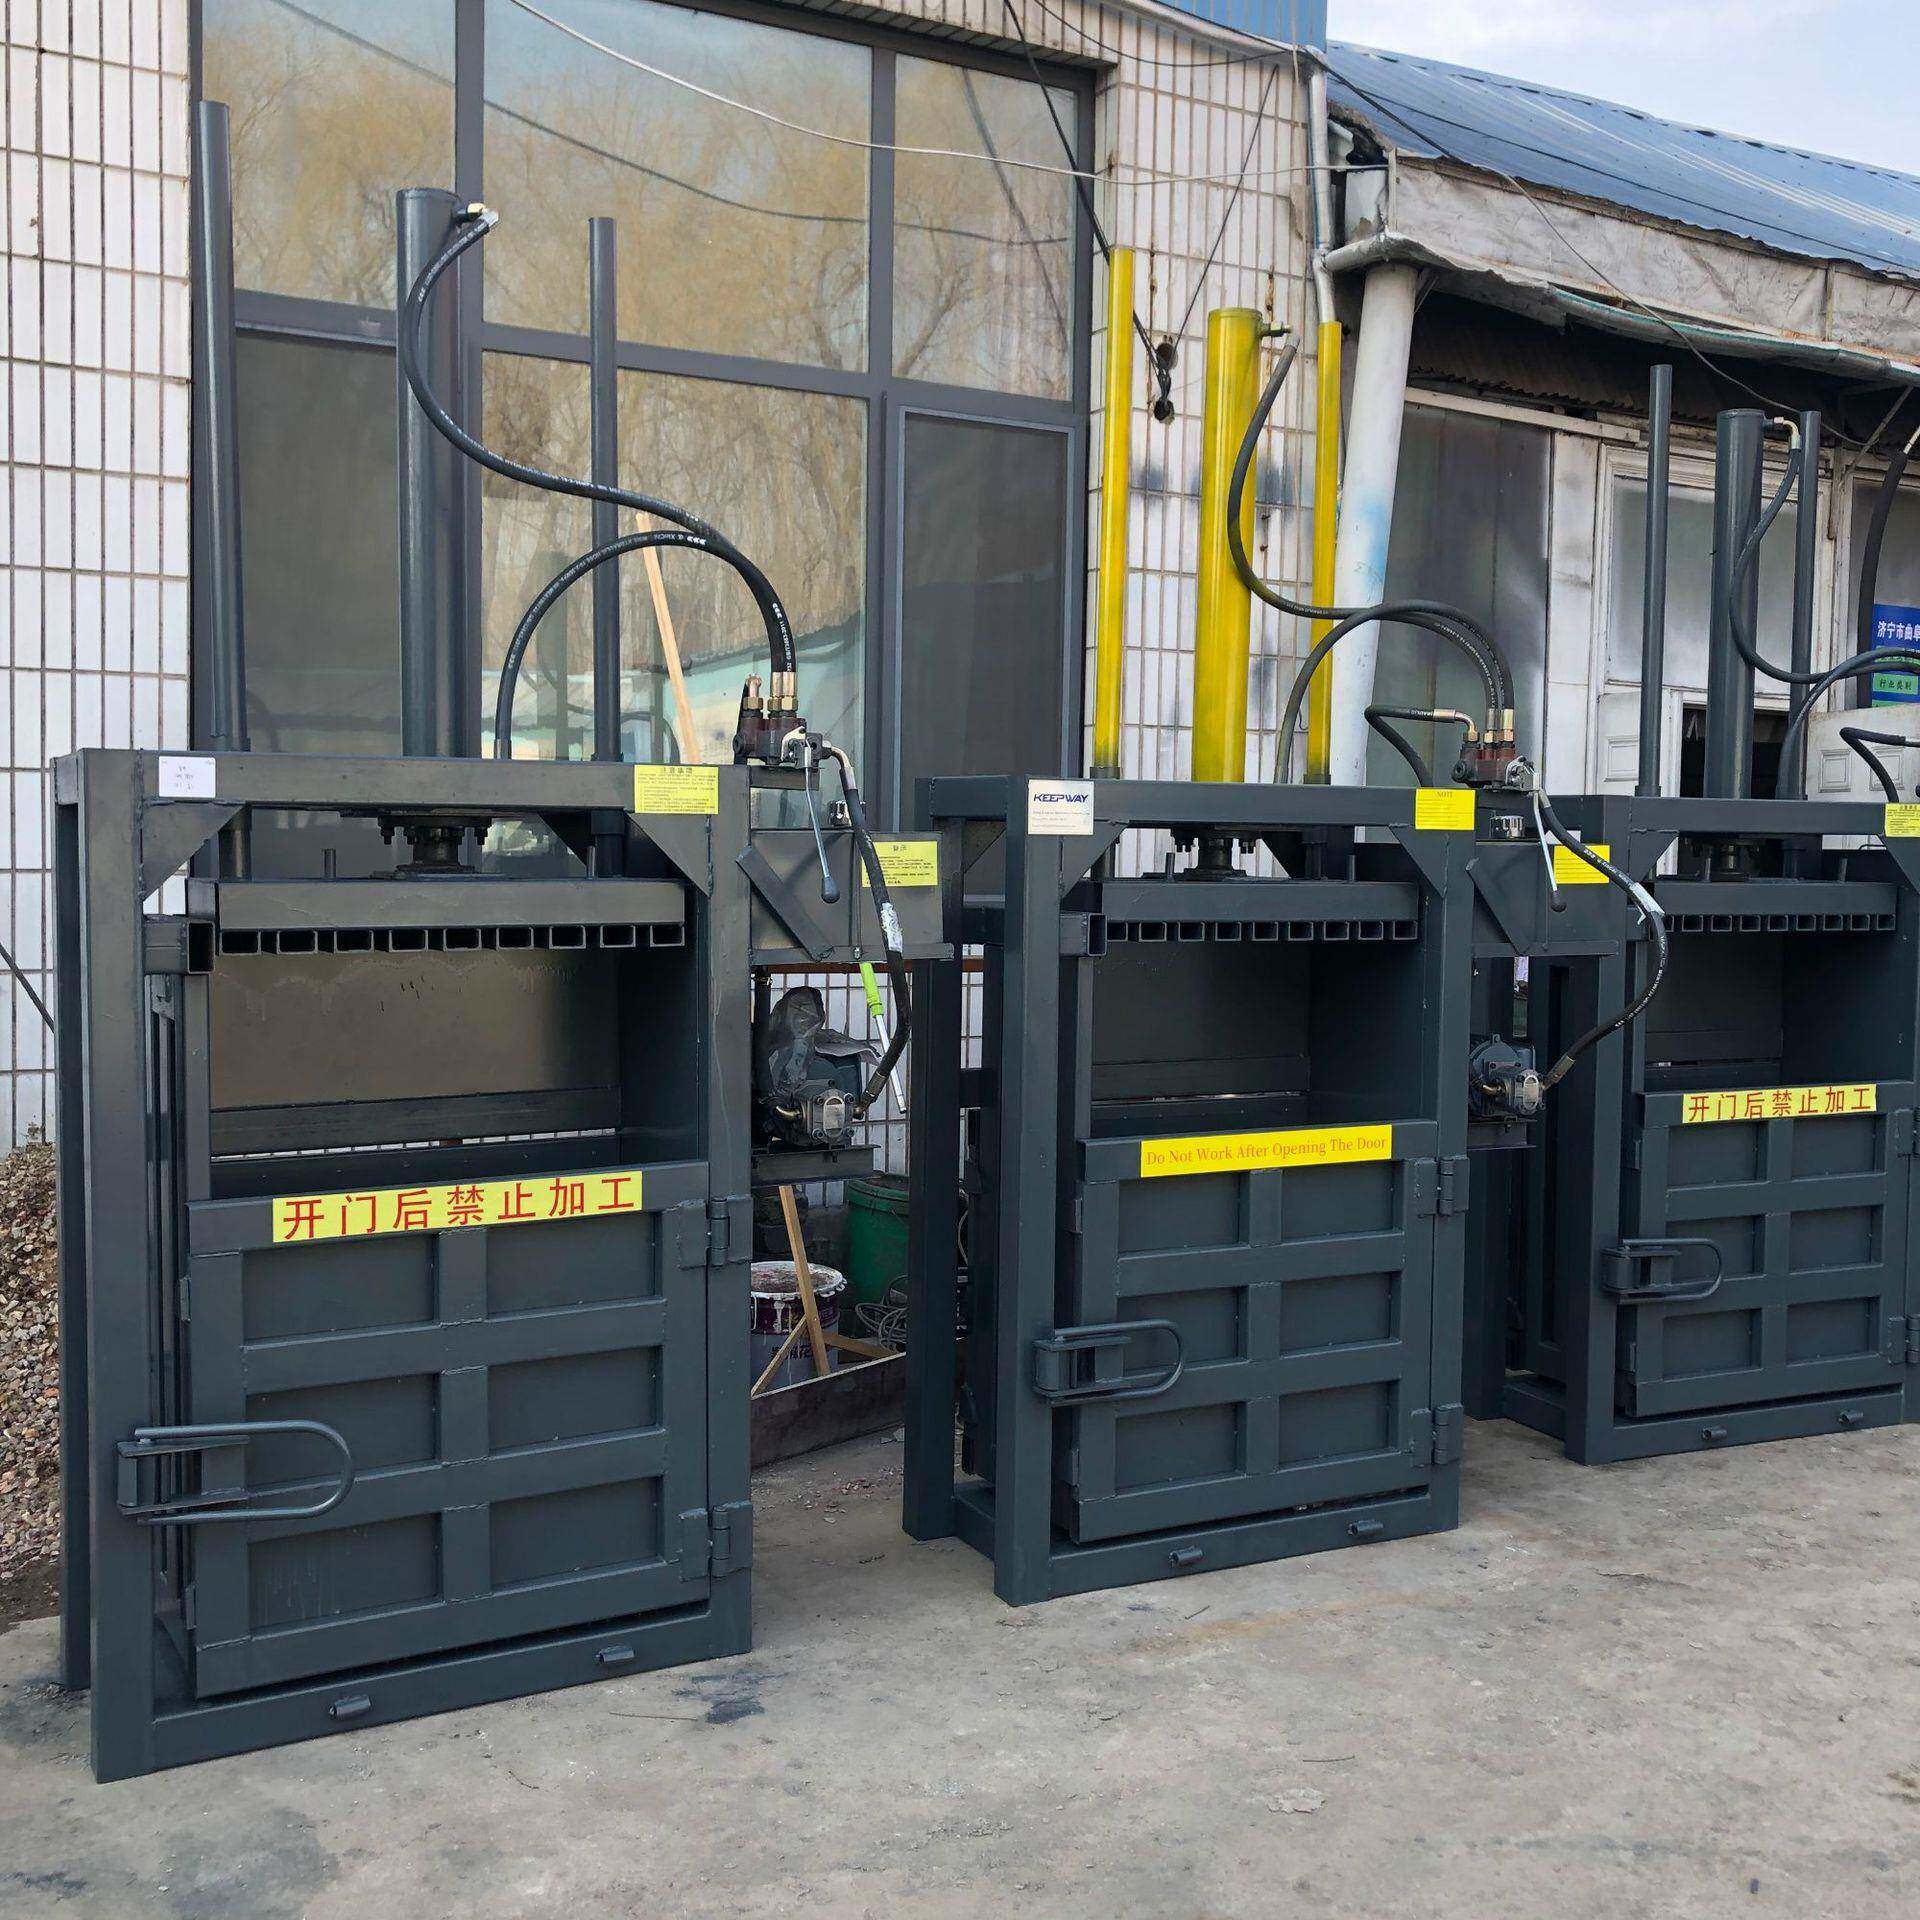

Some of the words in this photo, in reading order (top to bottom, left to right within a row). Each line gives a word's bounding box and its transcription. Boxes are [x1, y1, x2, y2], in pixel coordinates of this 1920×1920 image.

[1033, 793, 1089, 803] KEEPWAY
[1688, 1085, 1871, 1122] 开门后禁止加工
[1146, 1151, 1166, 1165] Do
[1169, 1149, 1193, 1164] Not
[1196, 1145, 1233, 1161] Work
[1236, 1143, 1269, 1159] After
[1272, 1139, 1327, 1159] Opening
[1330, 1137, 1354, 1152] The
[1356, 1136, 1387, 1151] Door
[283, 1177, 635, 1240] 开门后禁止加工
